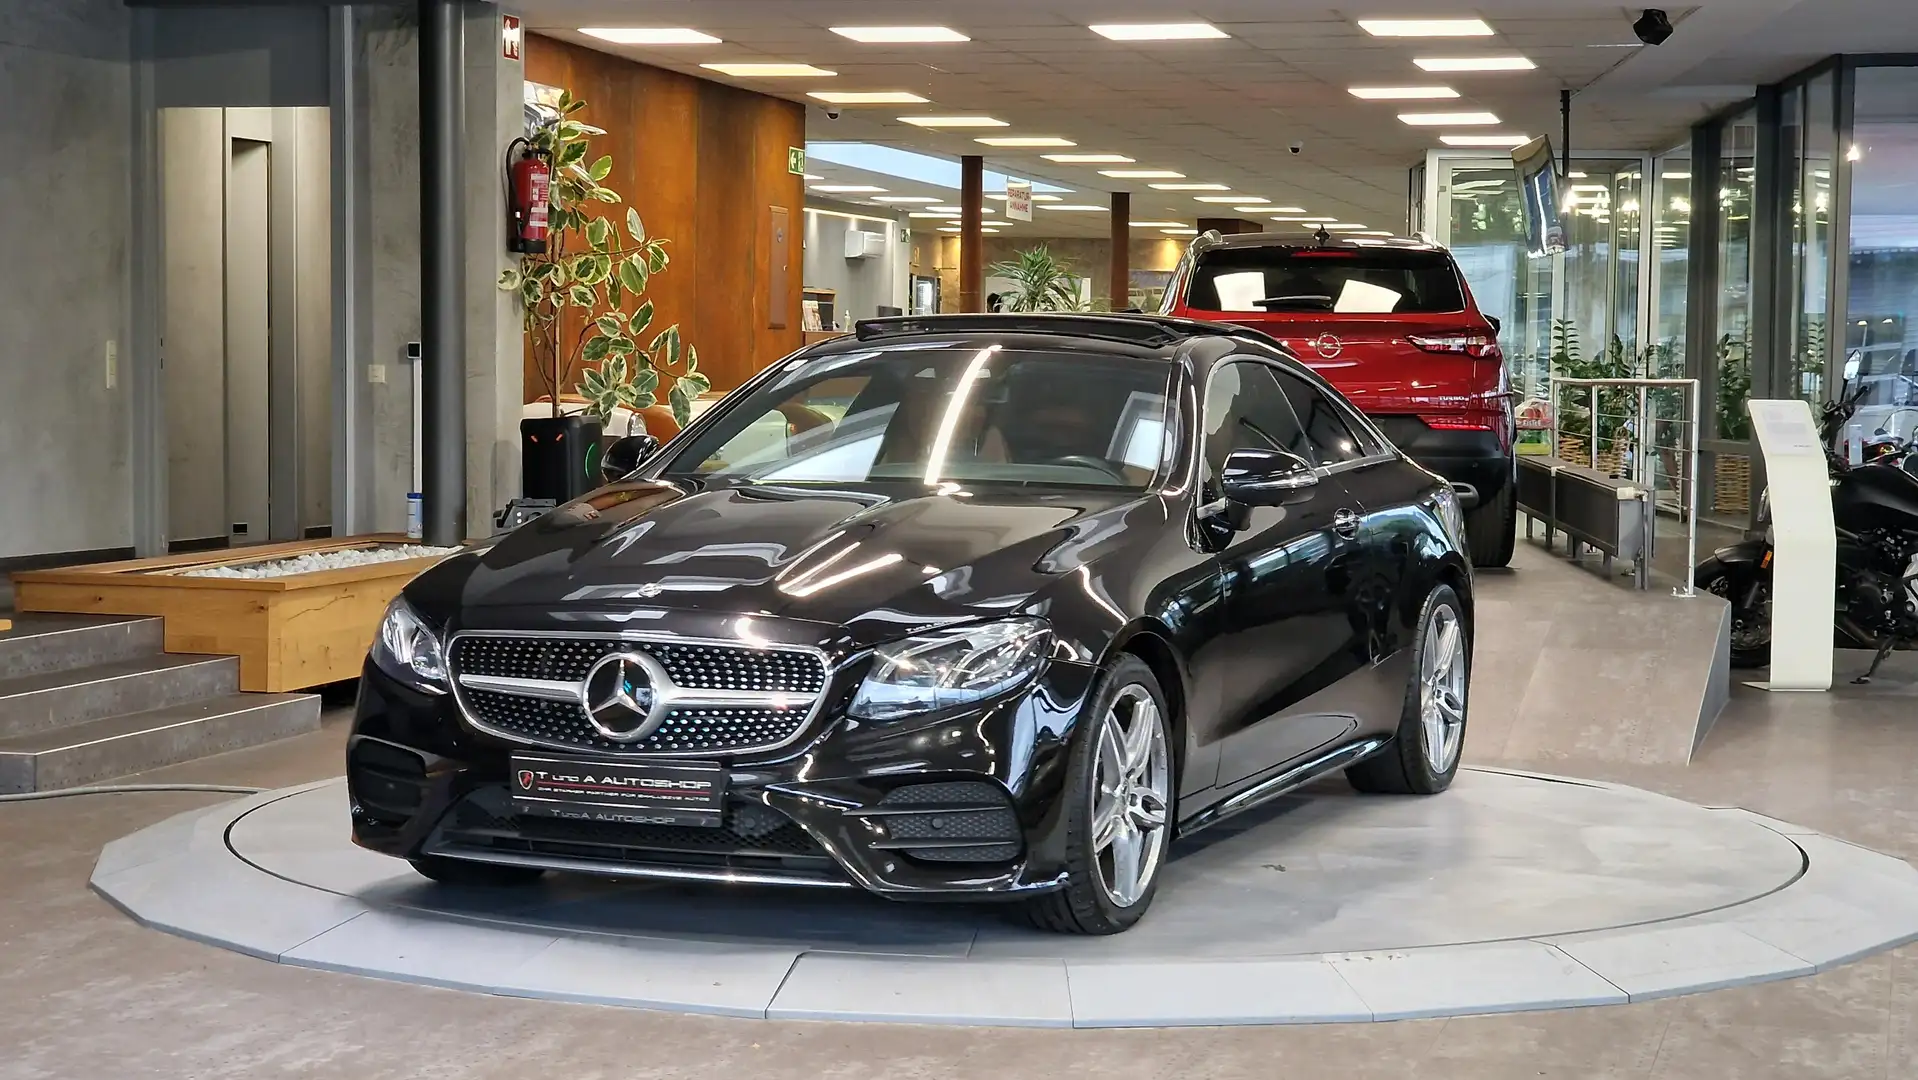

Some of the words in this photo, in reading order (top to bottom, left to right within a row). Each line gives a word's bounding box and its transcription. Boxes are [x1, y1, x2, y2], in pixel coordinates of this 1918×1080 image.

[536, 771, 548, 779] T
[583, 775, 596, 783] A
[601, 776, 711, 789] AUTOSHOP
[551, 809, 560, 817] T
[580, 812, 591, 820] A
[595, 813, 676, 825] AUTOSHOP
